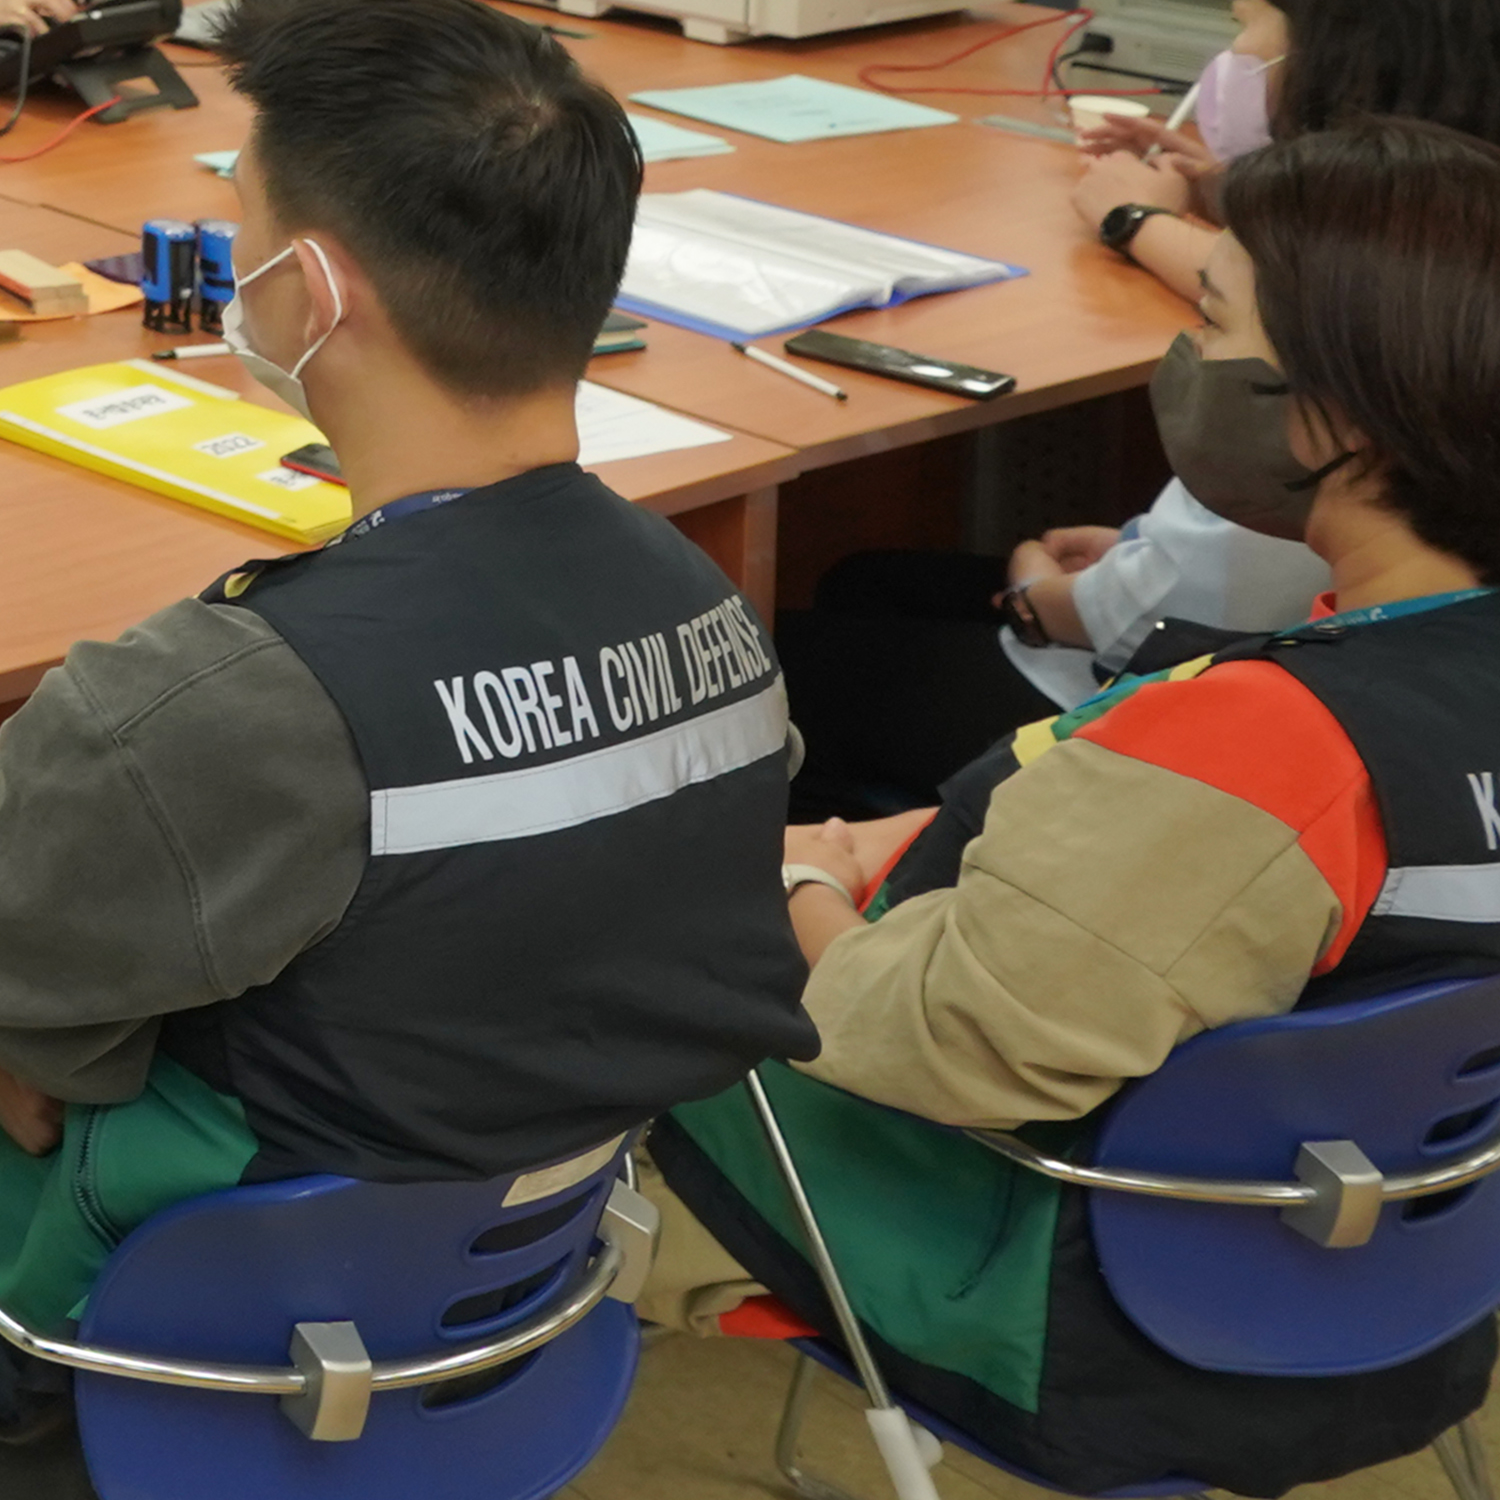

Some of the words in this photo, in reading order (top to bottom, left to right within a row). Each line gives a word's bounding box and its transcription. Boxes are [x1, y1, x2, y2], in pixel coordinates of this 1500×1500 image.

[434, 655, 600, 764] KOREA
[599, 632, 683, 732] CIVIL
[676, 594, 772, 705] DEFENSE
